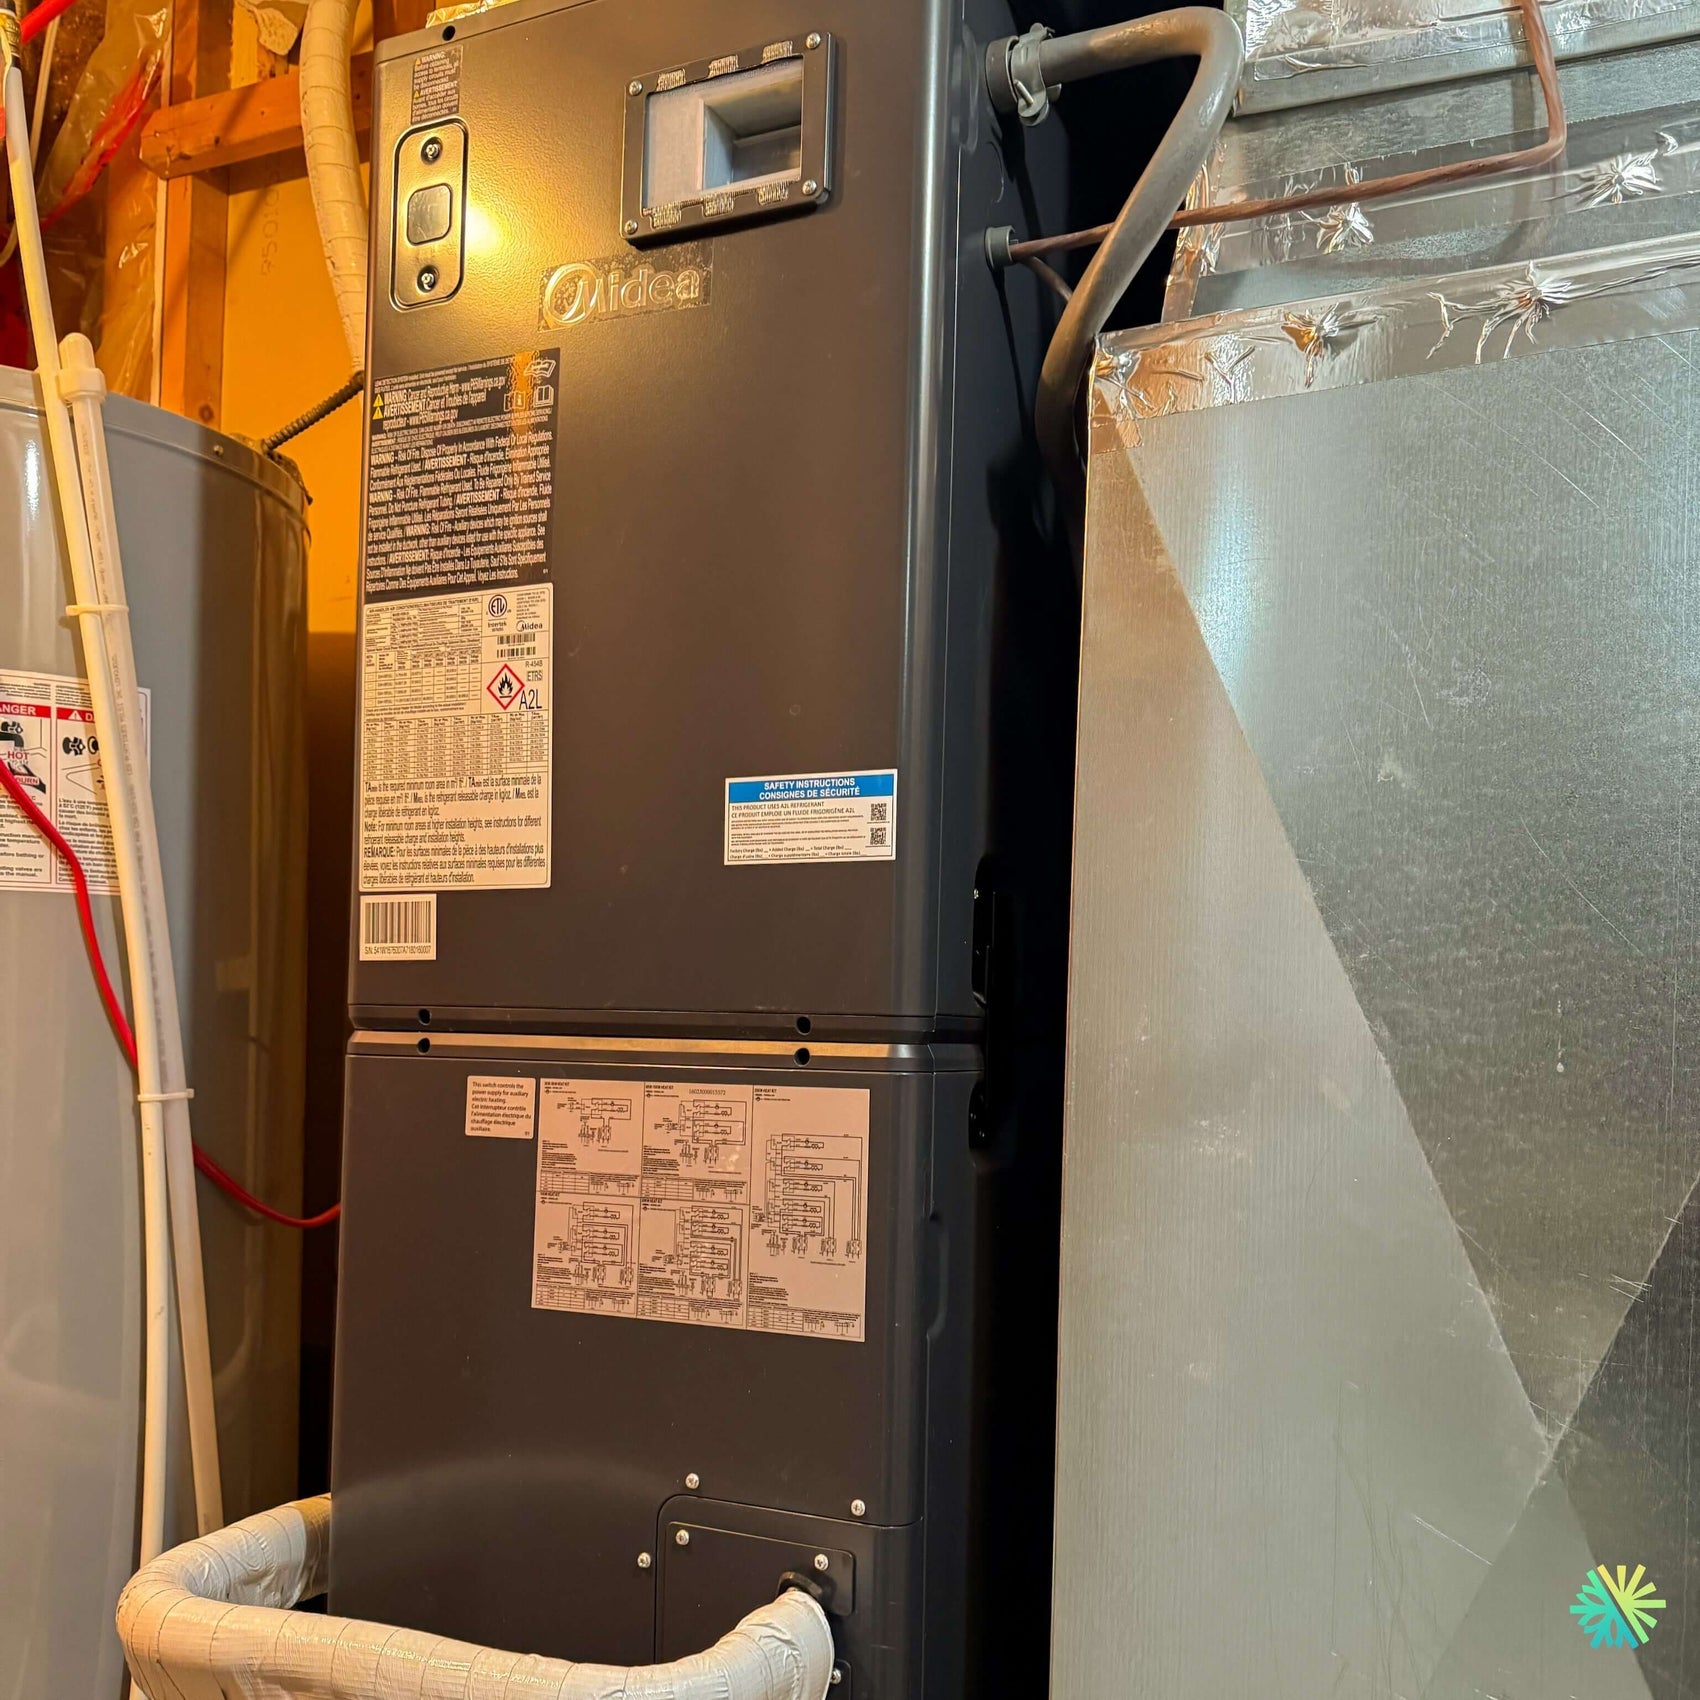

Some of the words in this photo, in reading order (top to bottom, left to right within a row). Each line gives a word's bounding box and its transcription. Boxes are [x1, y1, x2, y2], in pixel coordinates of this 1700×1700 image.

[545, 263, 700, 324] Midea
[516, 620, 543, 632] Midea
[519, 688, 542, 710] A2L
[0, 704, 36, 716] NGER
[8, 751, 29, 759] HOT
[764, 781, 795, 790] SAFETY
[796, 778, 855, 789] INSTRUCTIONS
[760, 790, 805, 800] CONSIGNES
[808, 790, 818, 798] DE
[820, 785, 860, 797] SÉCURITÉ
[510, 1091, 529, 1099] auxiliary
